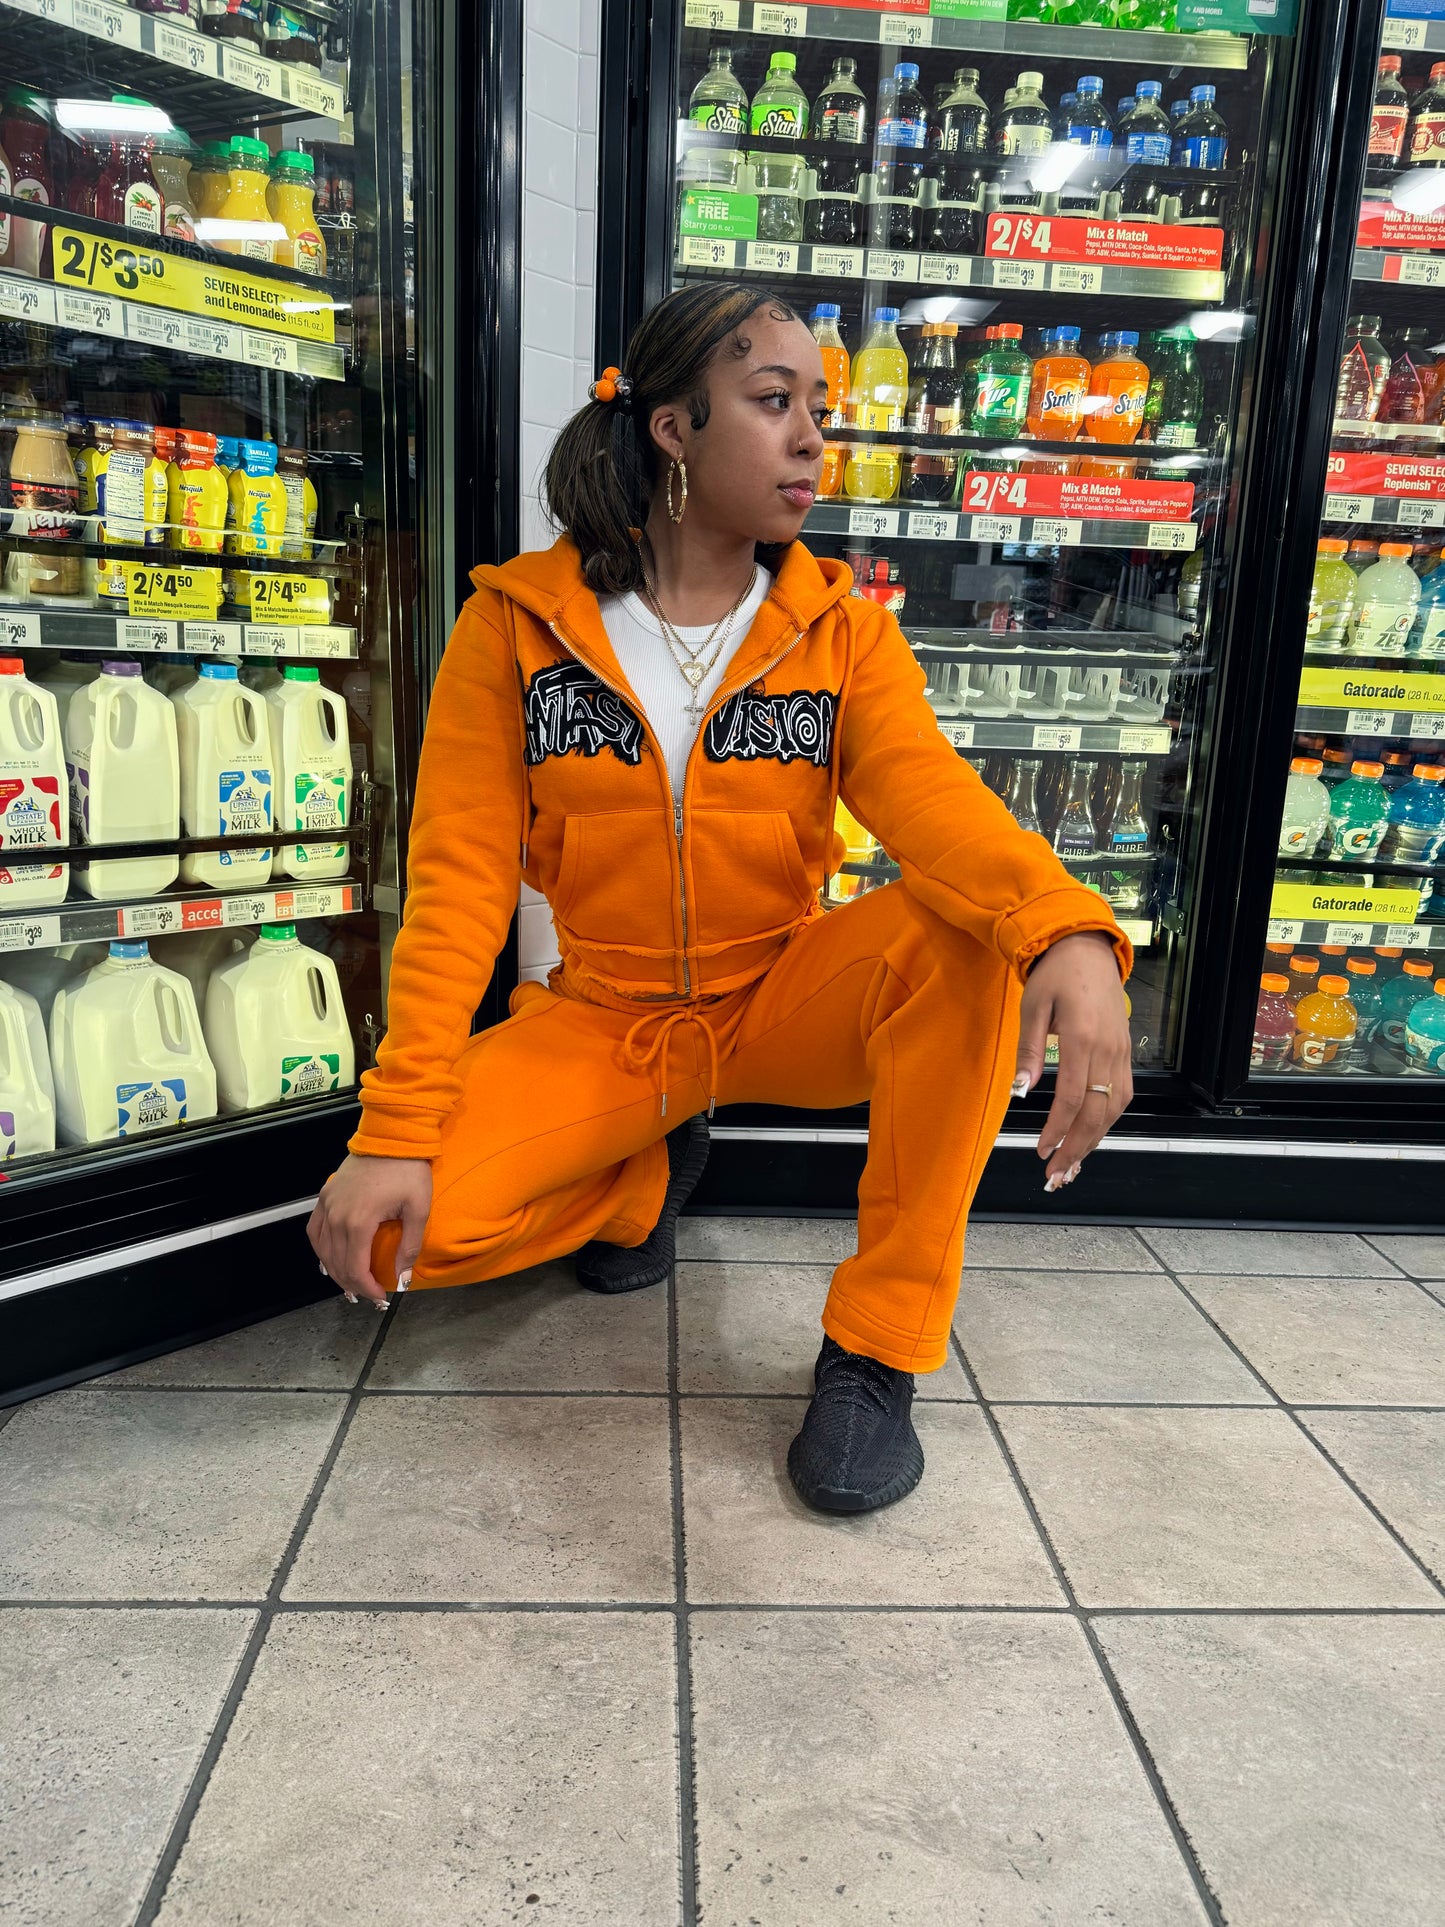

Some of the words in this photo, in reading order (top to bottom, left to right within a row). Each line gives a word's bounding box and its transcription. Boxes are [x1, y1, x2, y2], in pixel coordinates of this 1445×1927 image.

[698, 204, 729, 220] FREE
[1384, 210, 1403, 222] Mix
[1404, 212, 1410, 223] &
[684, 220, 708, 231] Starry
[1087, 227, 1105, 239] Mix
[1107, 228, 1114, 240] &
[1116, 228, 1148, 242] Match
[204, 276, 240, 296] SEVEN
[205, 294, 224, 308] and
[227, 298, 286, 322] Lemonades
[249, 449, 269, 457] VANILLA
[1386, 463, 1417, 475] SEVEN
[179, 484, 203, 493] Nesquik
[248, 490, 271, 499] Nesquik
[1062, 482, 1080, 494] Mix
[1081, 484, 1088, 494] &
[1090, 484, 1121, 496] Match
[1343, 682, 1405, 699] Gatorade
[11, 813, 42, 821] UPSTATE
[312, 818, 337, 827] MILK
[14, 826, 45, 834] WHOLE
[231, 819, 261, 830] MILK
[10, 832, 47, 845] MILK
[1343, 827, 1374, 854] G
[1115, 844, 1144, 852] PURE
[1312, 896, 1372, 911] Gatorade
[1303, 1041, 1326, 1064] G
[300, 1082, 323, 1092] MILK
[138, 1110, 168, 1125] MILK
